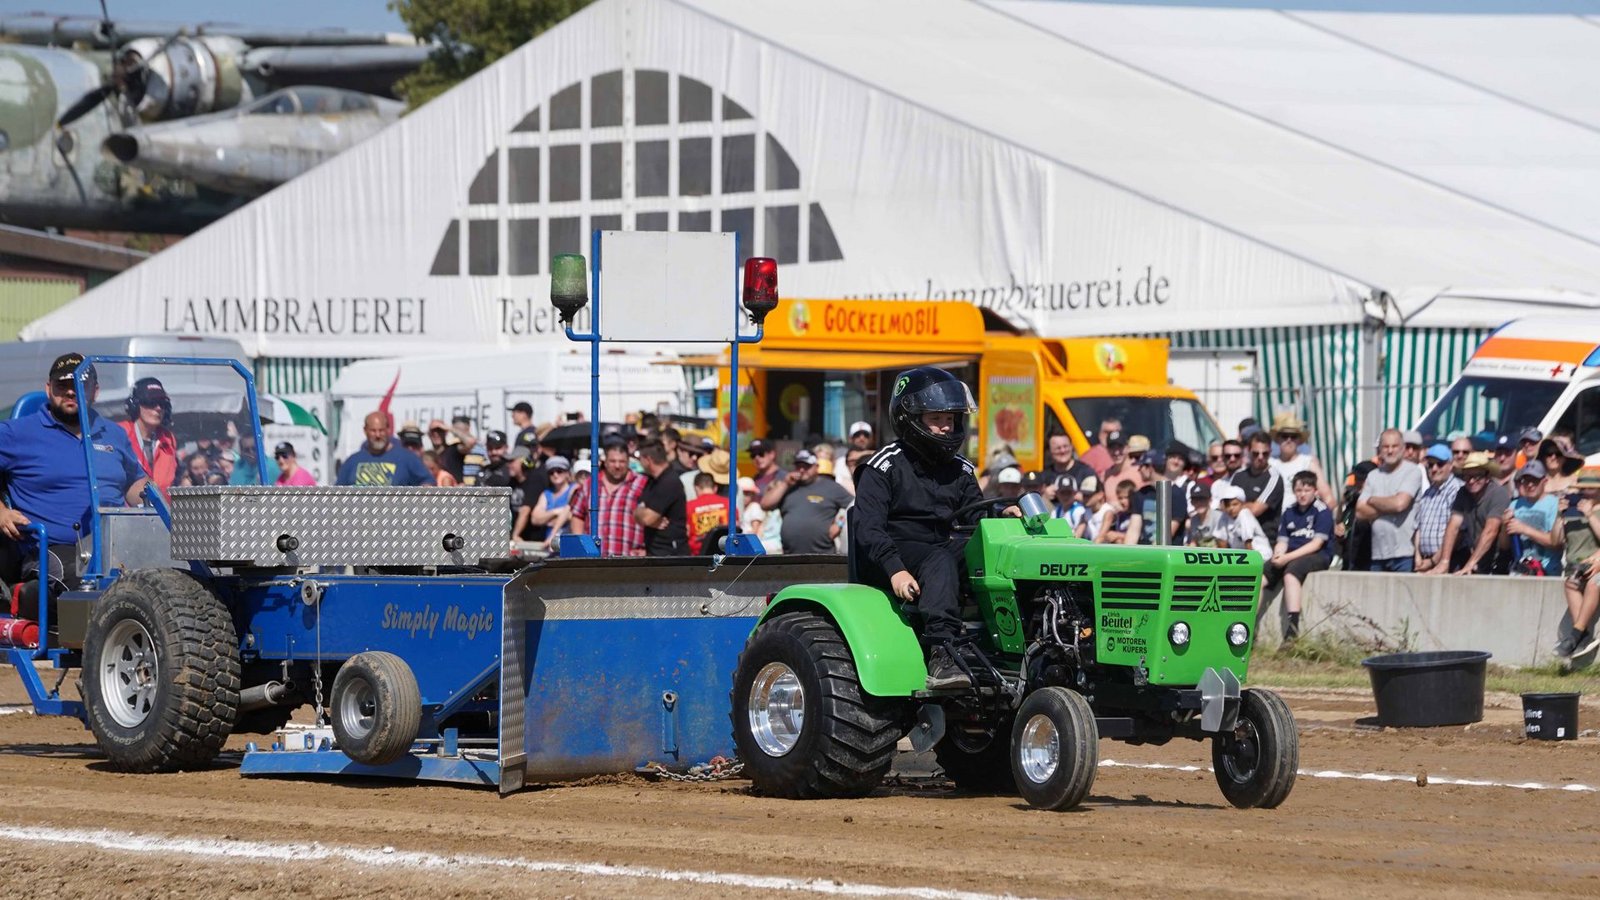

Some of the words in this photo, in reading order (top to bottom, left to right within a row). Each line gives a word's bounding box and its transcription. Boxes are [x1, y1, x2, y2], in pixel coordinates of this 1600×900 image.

[162, 297, 426, 334] LAMMBRAUEREI
[824, 303, 940, 335] GOCKELMOBIL
[1184, 552, 1249, 565] DEUTZ
[1039, 563, 1088, 576] DEUTZ
[381, 602, 440, 639] Simply
[442, 605, 493, 641] Magic
[1101, 615, 1133, 629] Beutel
[1116, 636, 1147, 646] MOTOREN
